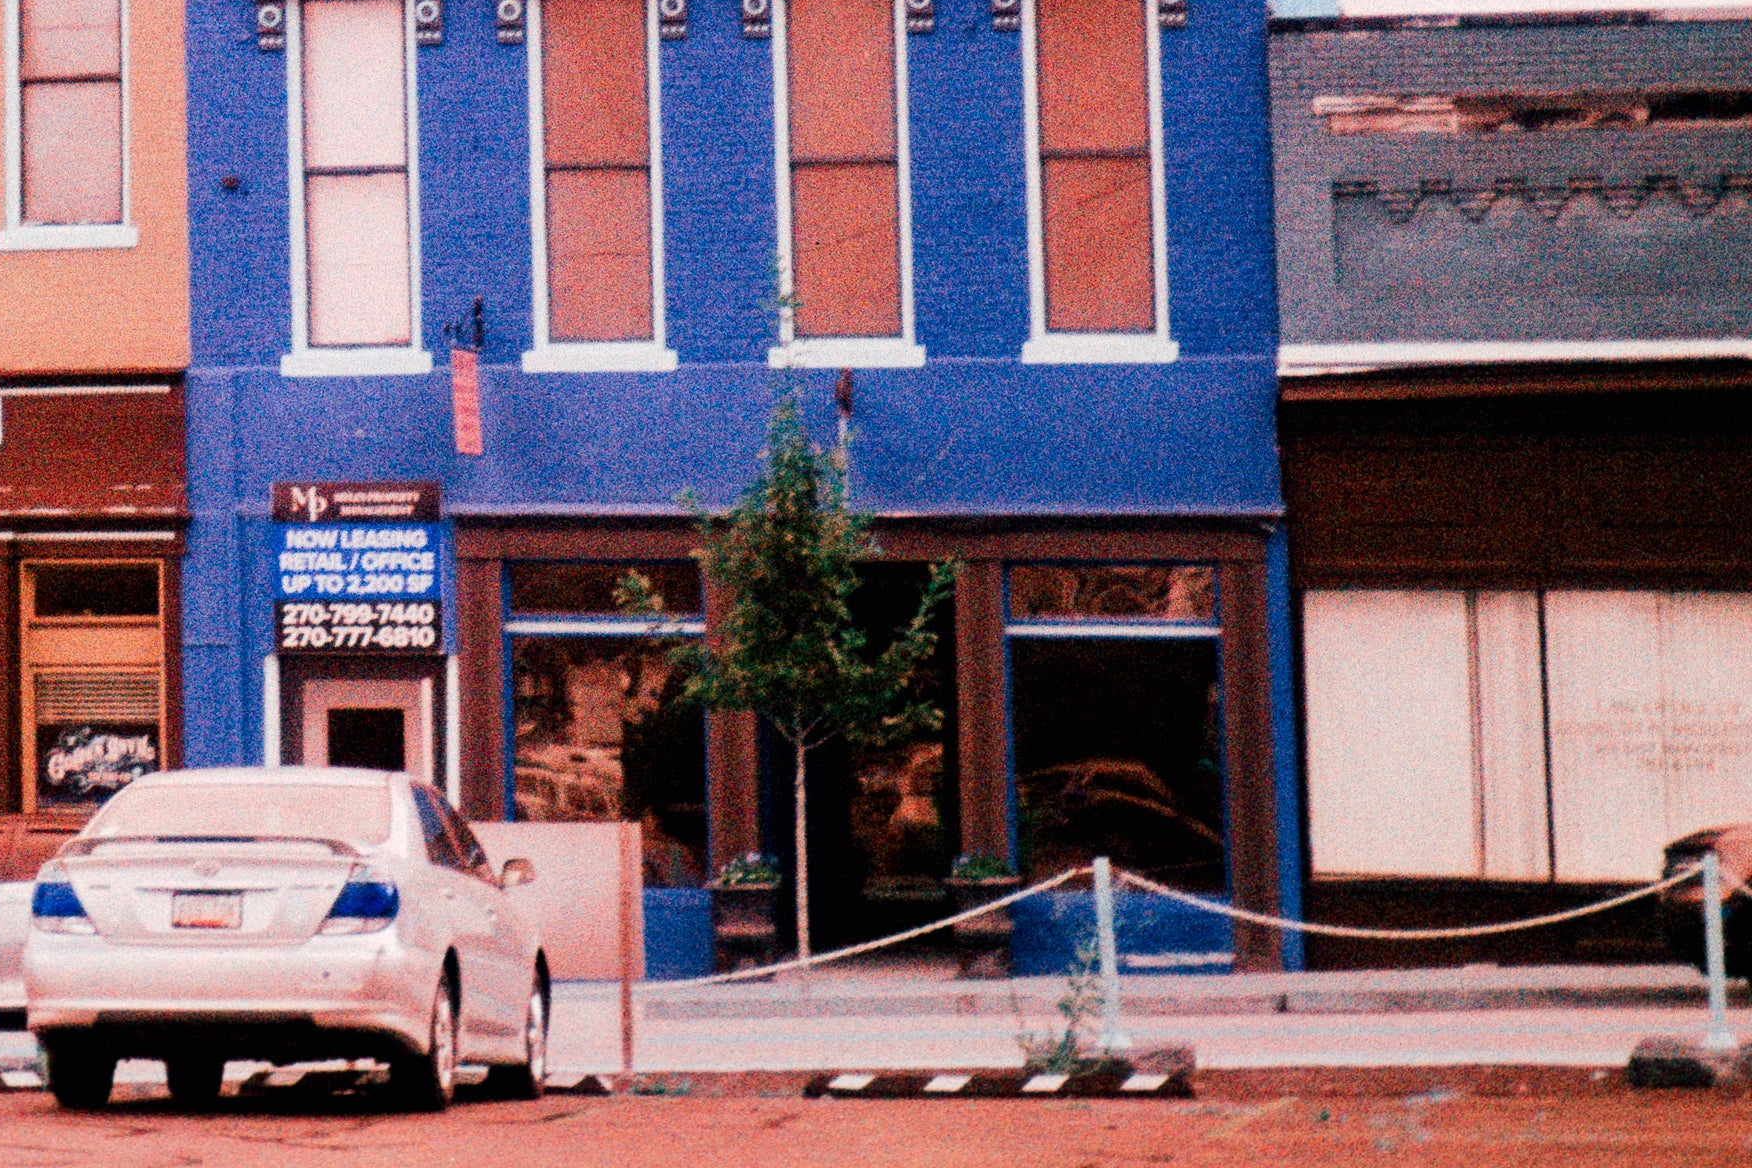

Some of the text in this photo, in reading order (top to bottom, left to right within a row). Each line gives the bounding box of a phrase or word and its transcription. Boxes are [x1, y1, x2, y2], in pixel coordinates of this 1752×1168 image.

[286, 528, 428, 549] NOW LEASING
[279, 552, 347, 571] RETAIL
[361, 551, 434, 571] OFFICE
[281, 574, 312, 594] UP
[314, 574, 344, 594] TO
[407, 574, 435, 593] SF
